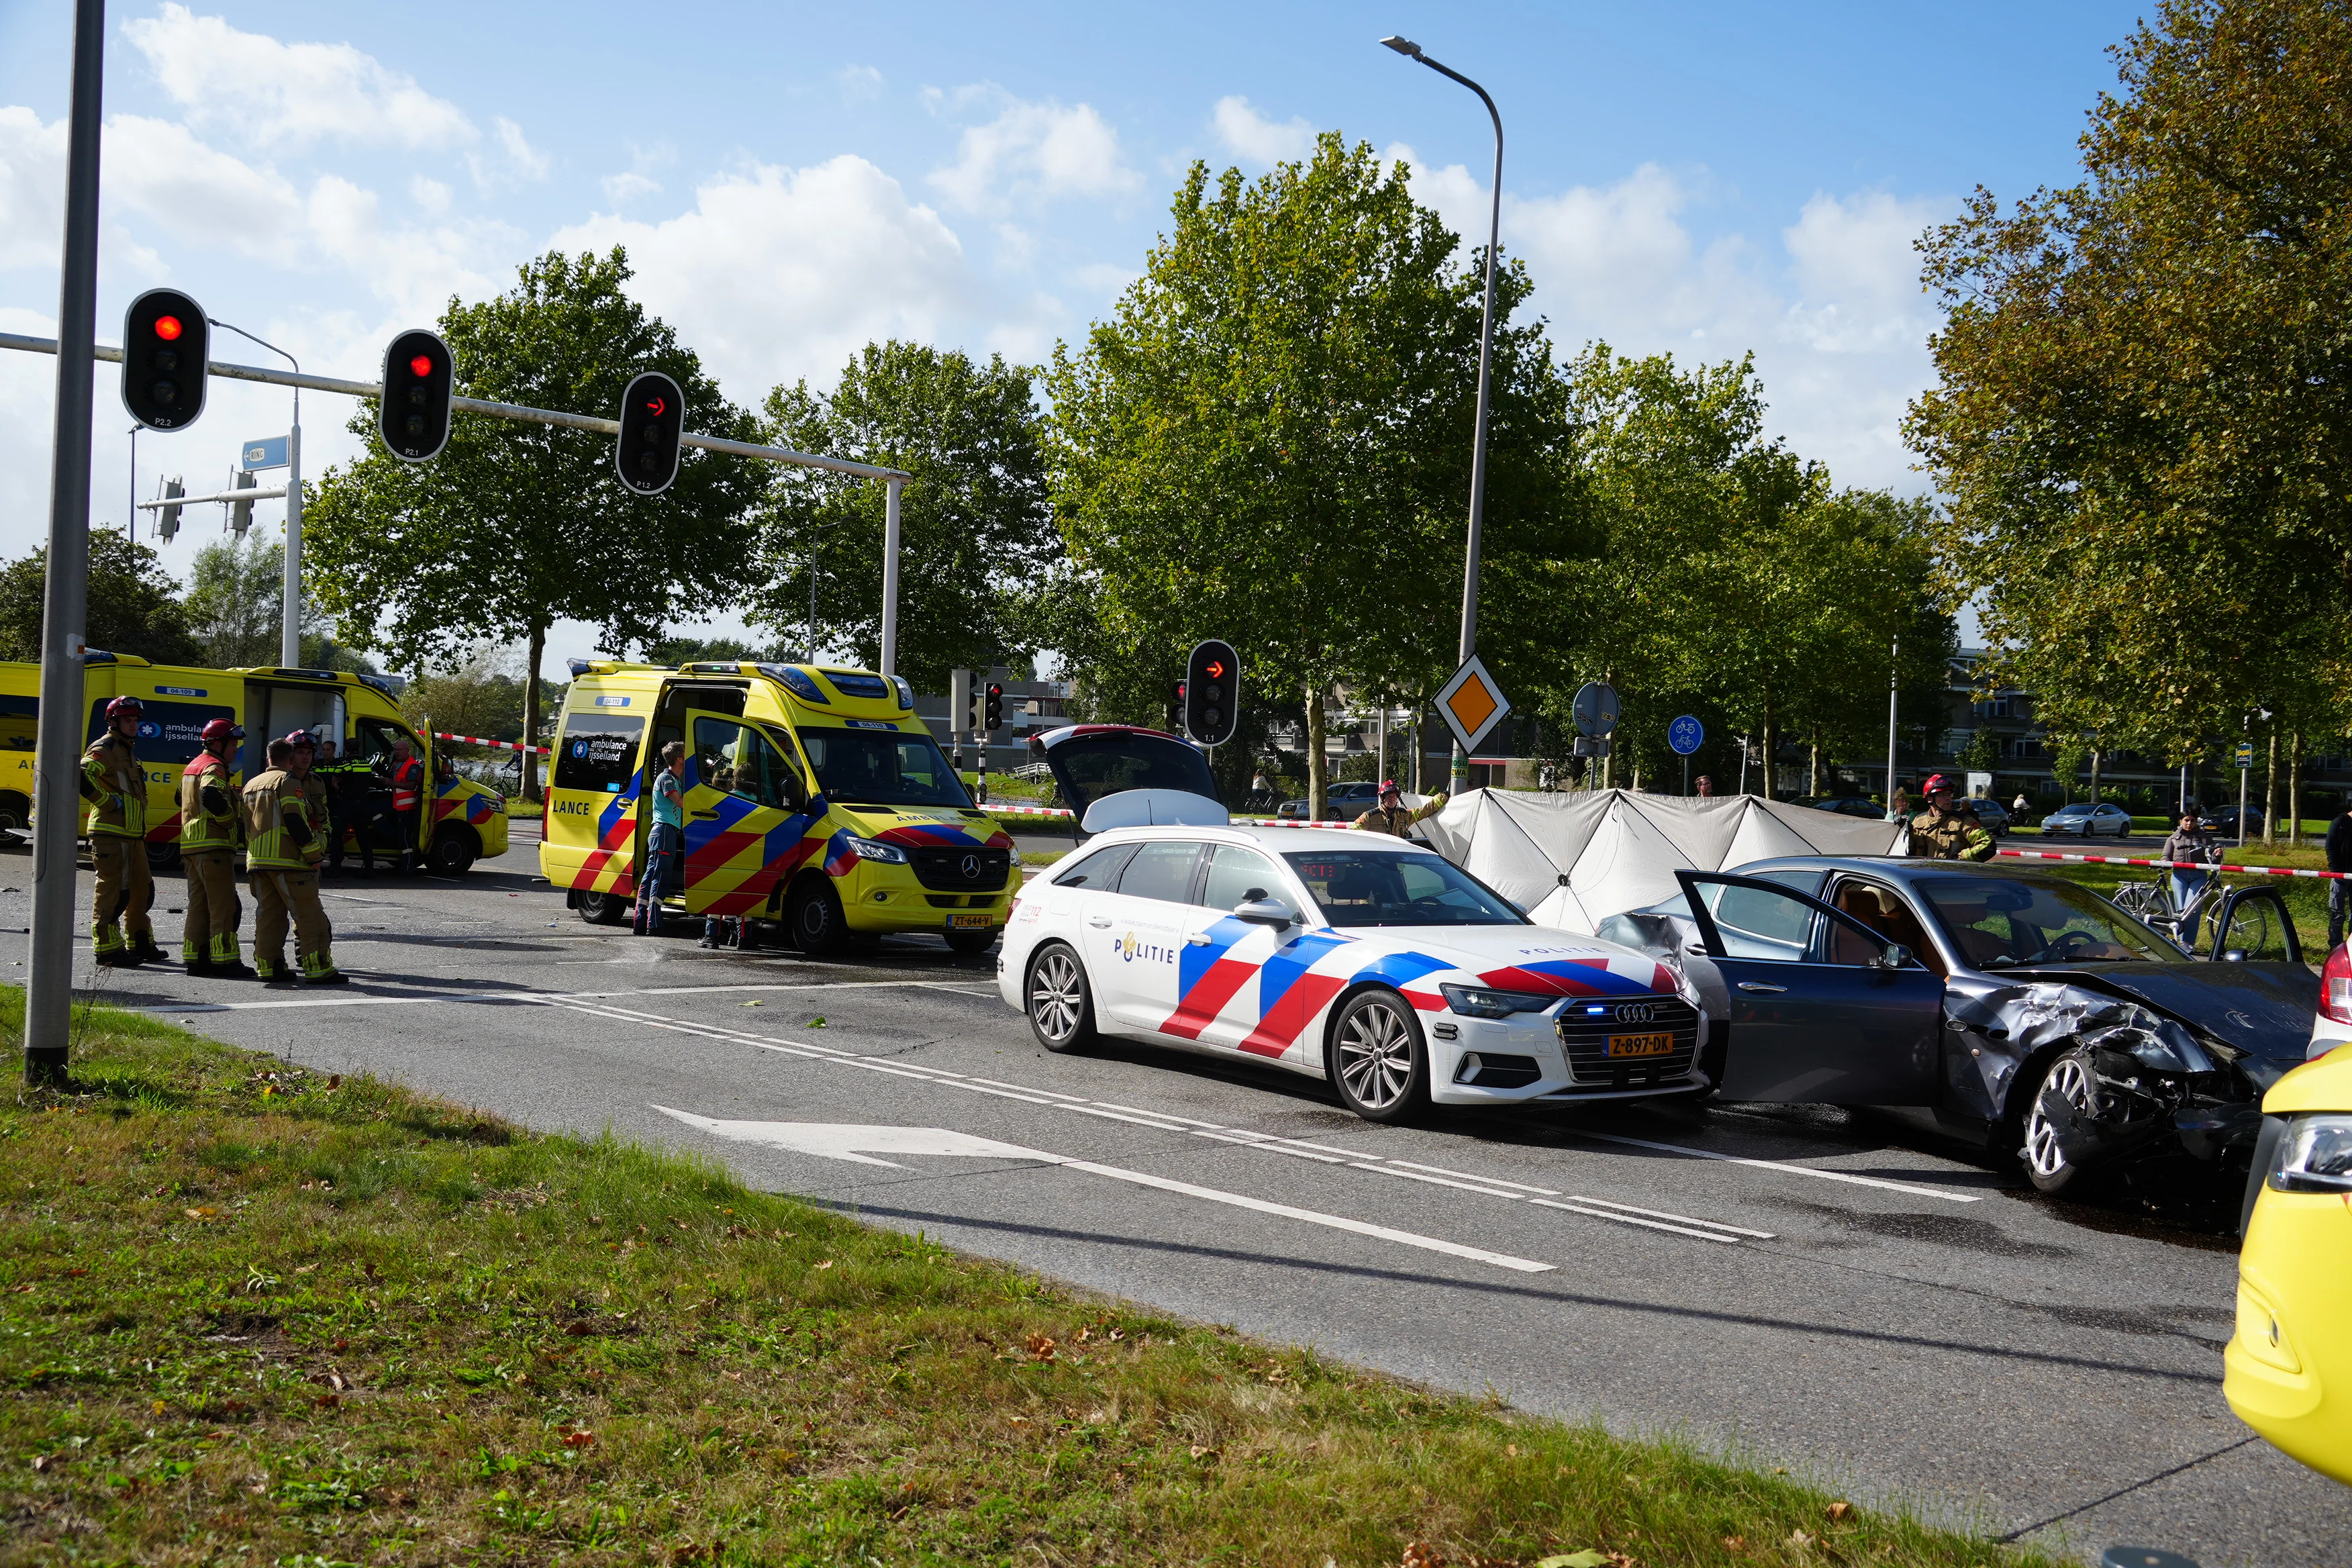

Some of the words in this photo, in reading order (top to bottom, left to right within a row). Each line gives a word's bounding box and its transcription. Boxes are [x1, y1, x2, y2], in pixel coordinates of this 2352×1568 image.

[155, 418, 172, 426] P2.2
[250, 450, 264, 459] RING
[405, 448, 419, 456] P2.1
[165, 724, 203, 733] ambula
[591, 738, 627, 750] ambulance
[588, 749, 621, 762] ijsselland
[553, 799, 589, 815] LANCE
[897, 816, 987, 825] AMBULANCE
[1030, 906, 1042, 916] 112
[954, 916, 989, 926] ZT-644-V
[1114, 938, 1174, 964] POLITIE
[1613, 1036, 1669, 1055] Z-897-DK
